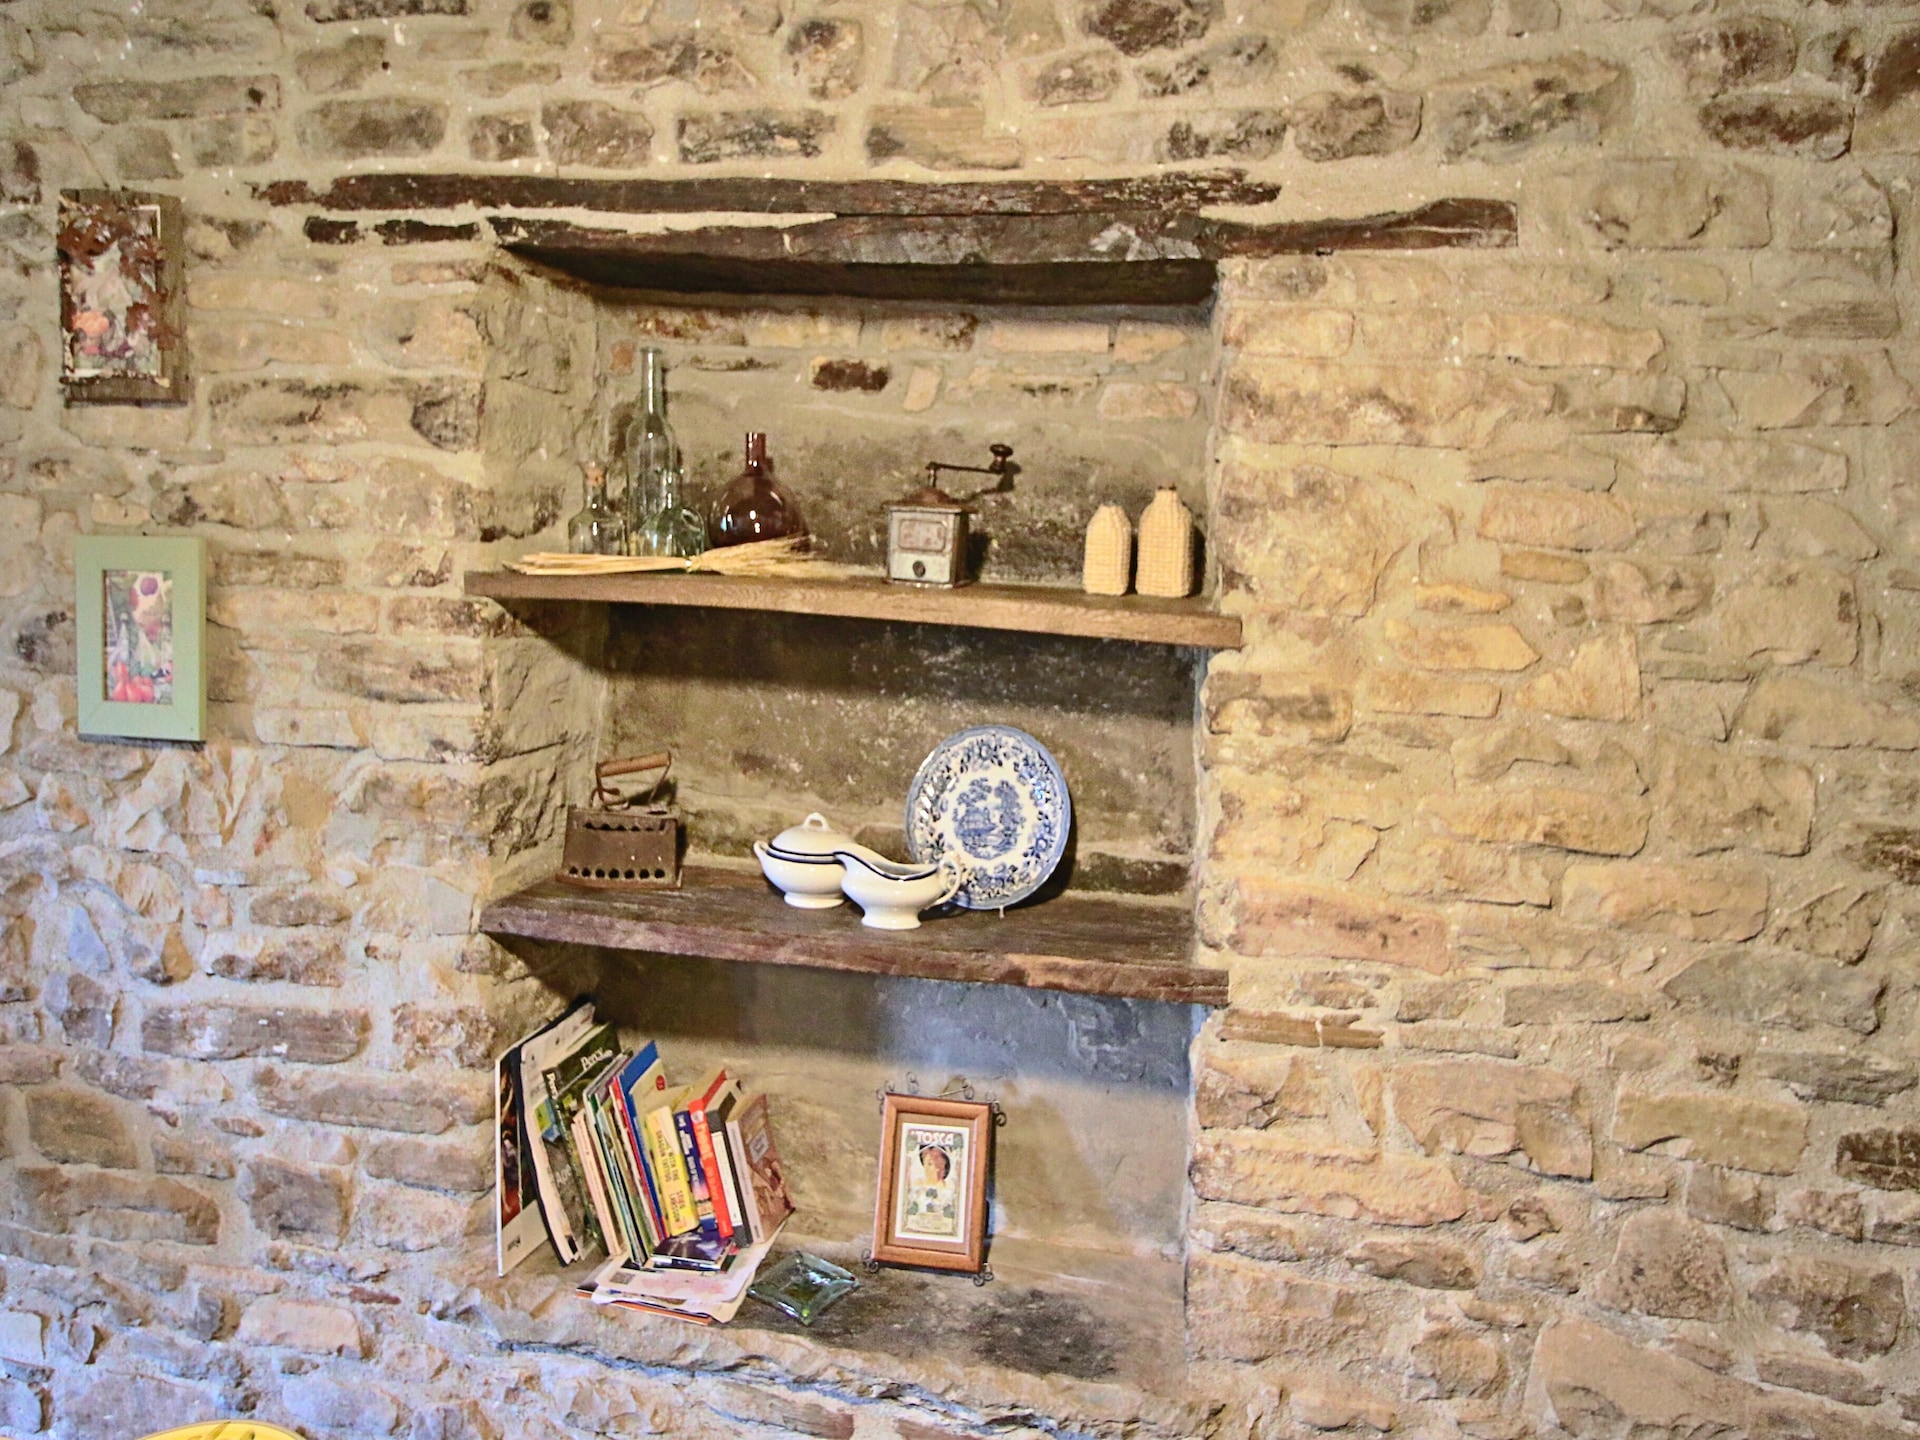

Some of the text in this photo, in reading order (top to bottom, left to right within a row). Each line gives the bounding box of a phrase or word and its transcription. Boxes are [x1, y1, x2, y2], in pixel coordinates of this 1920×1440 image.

[915, 1130, 954, 1146] TOSCA
[656, 1129, 672, 1182] DRAGON TATTOO
[668, 1151, 680, 1182] WITH THE
[669, 1192, 681, 1223] LARSSON
